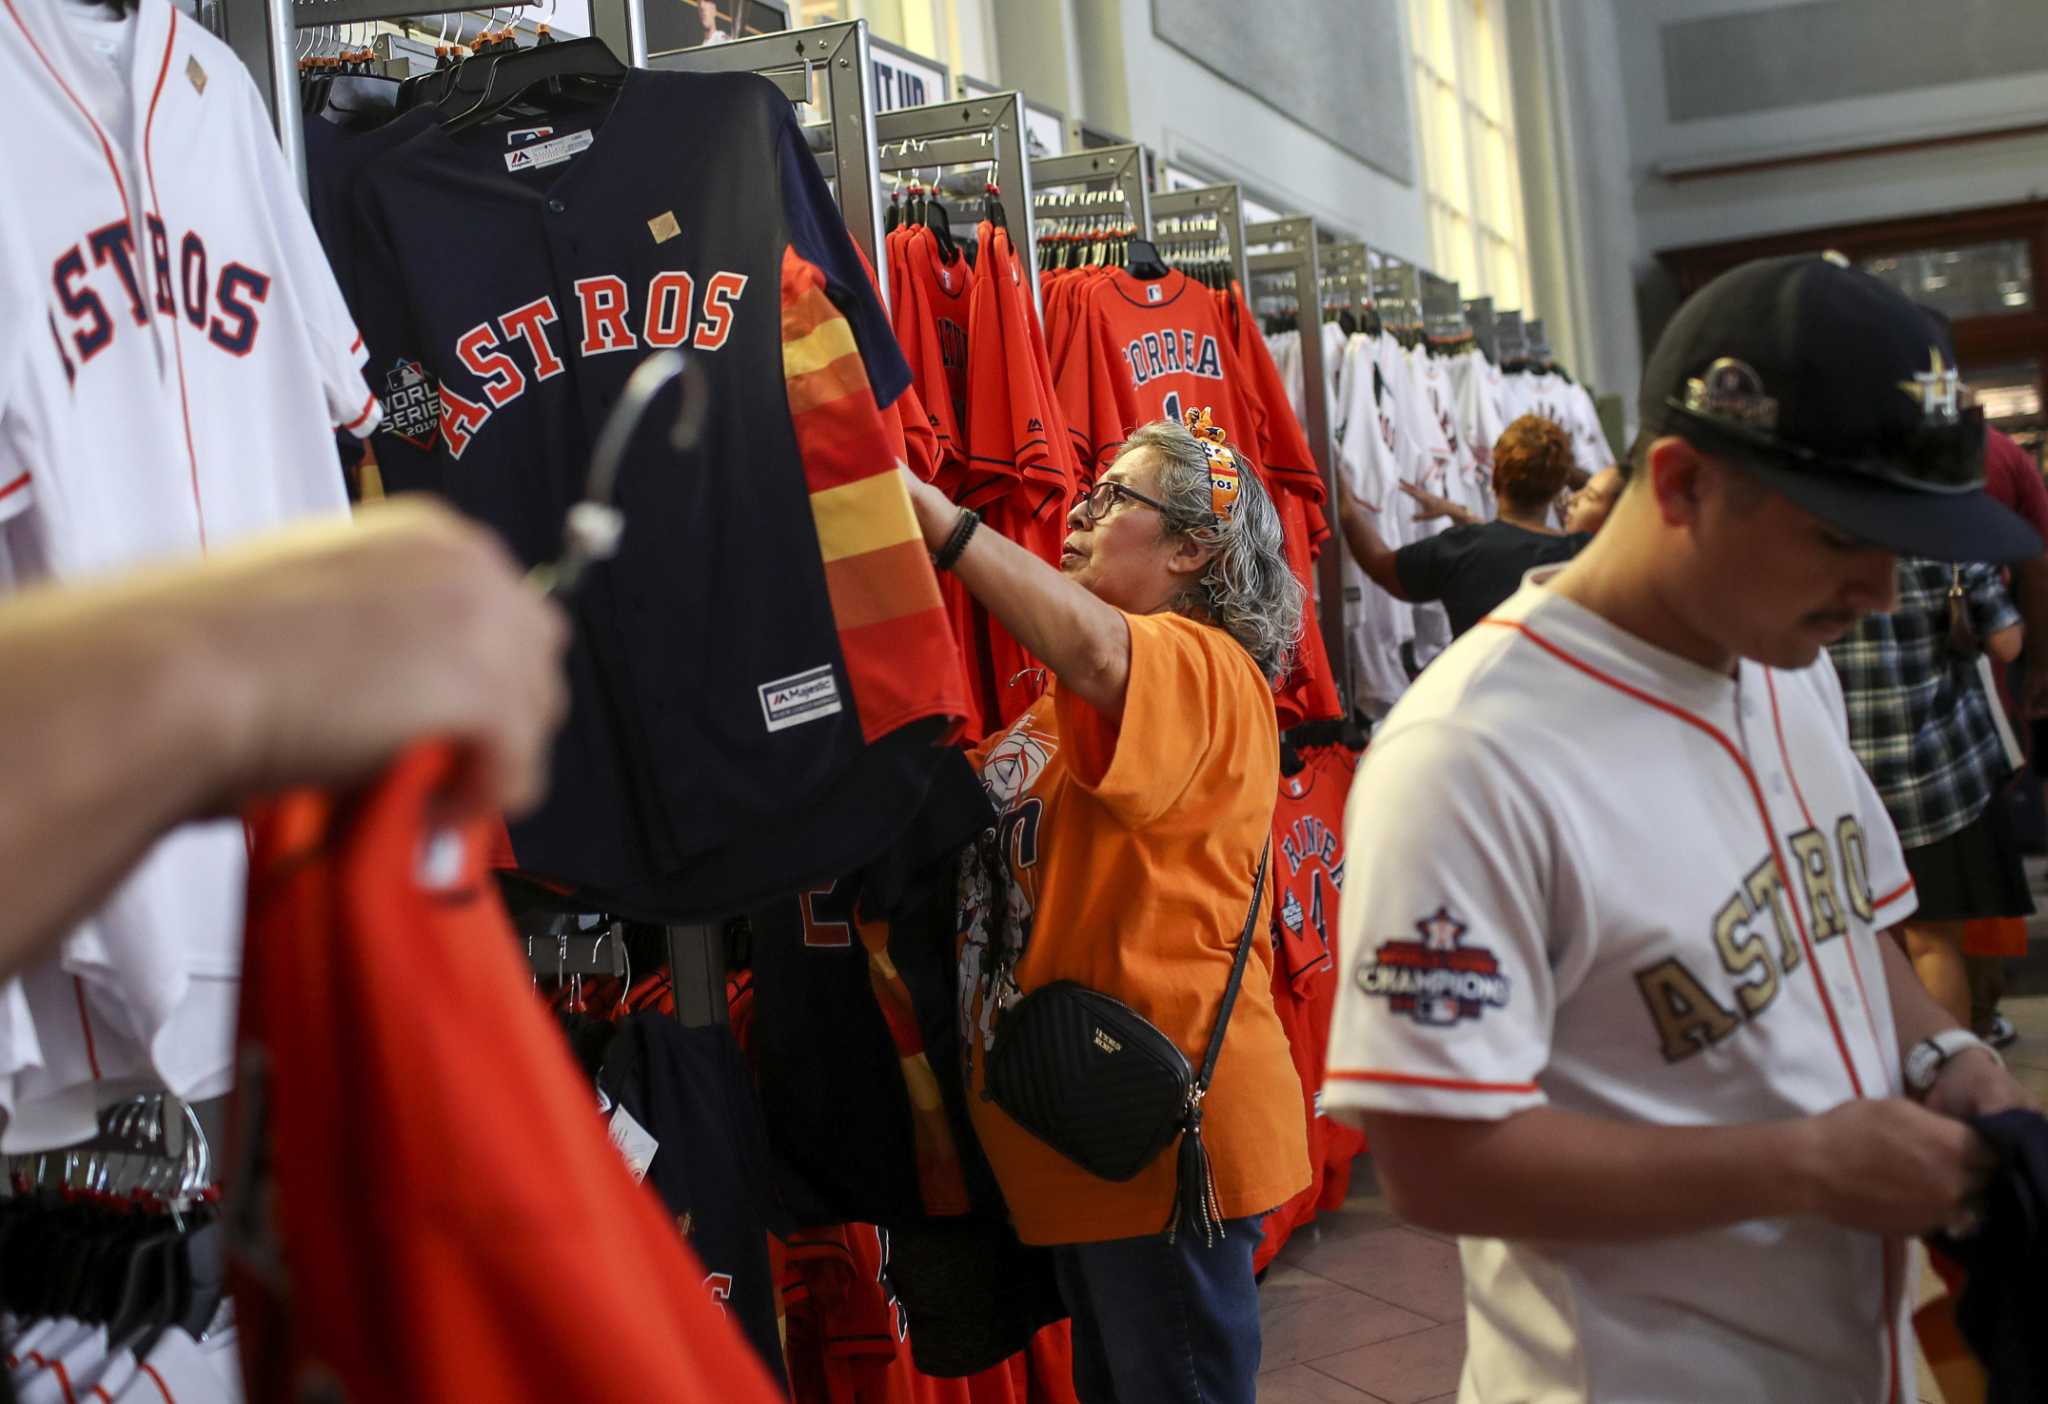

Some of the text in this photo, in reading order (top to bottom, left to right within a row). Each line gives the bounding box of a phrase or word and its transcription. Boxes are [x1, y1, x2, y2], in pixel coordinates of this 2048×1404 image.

[48, 211, 272, 389] STROS
[439, 270, 749, 461] ASTROS
[1122, 329, 1224, 390] ORREA
[381, 399, 441, 433] SERIE
[1633, 813, 1875, 1065] ASTRO
